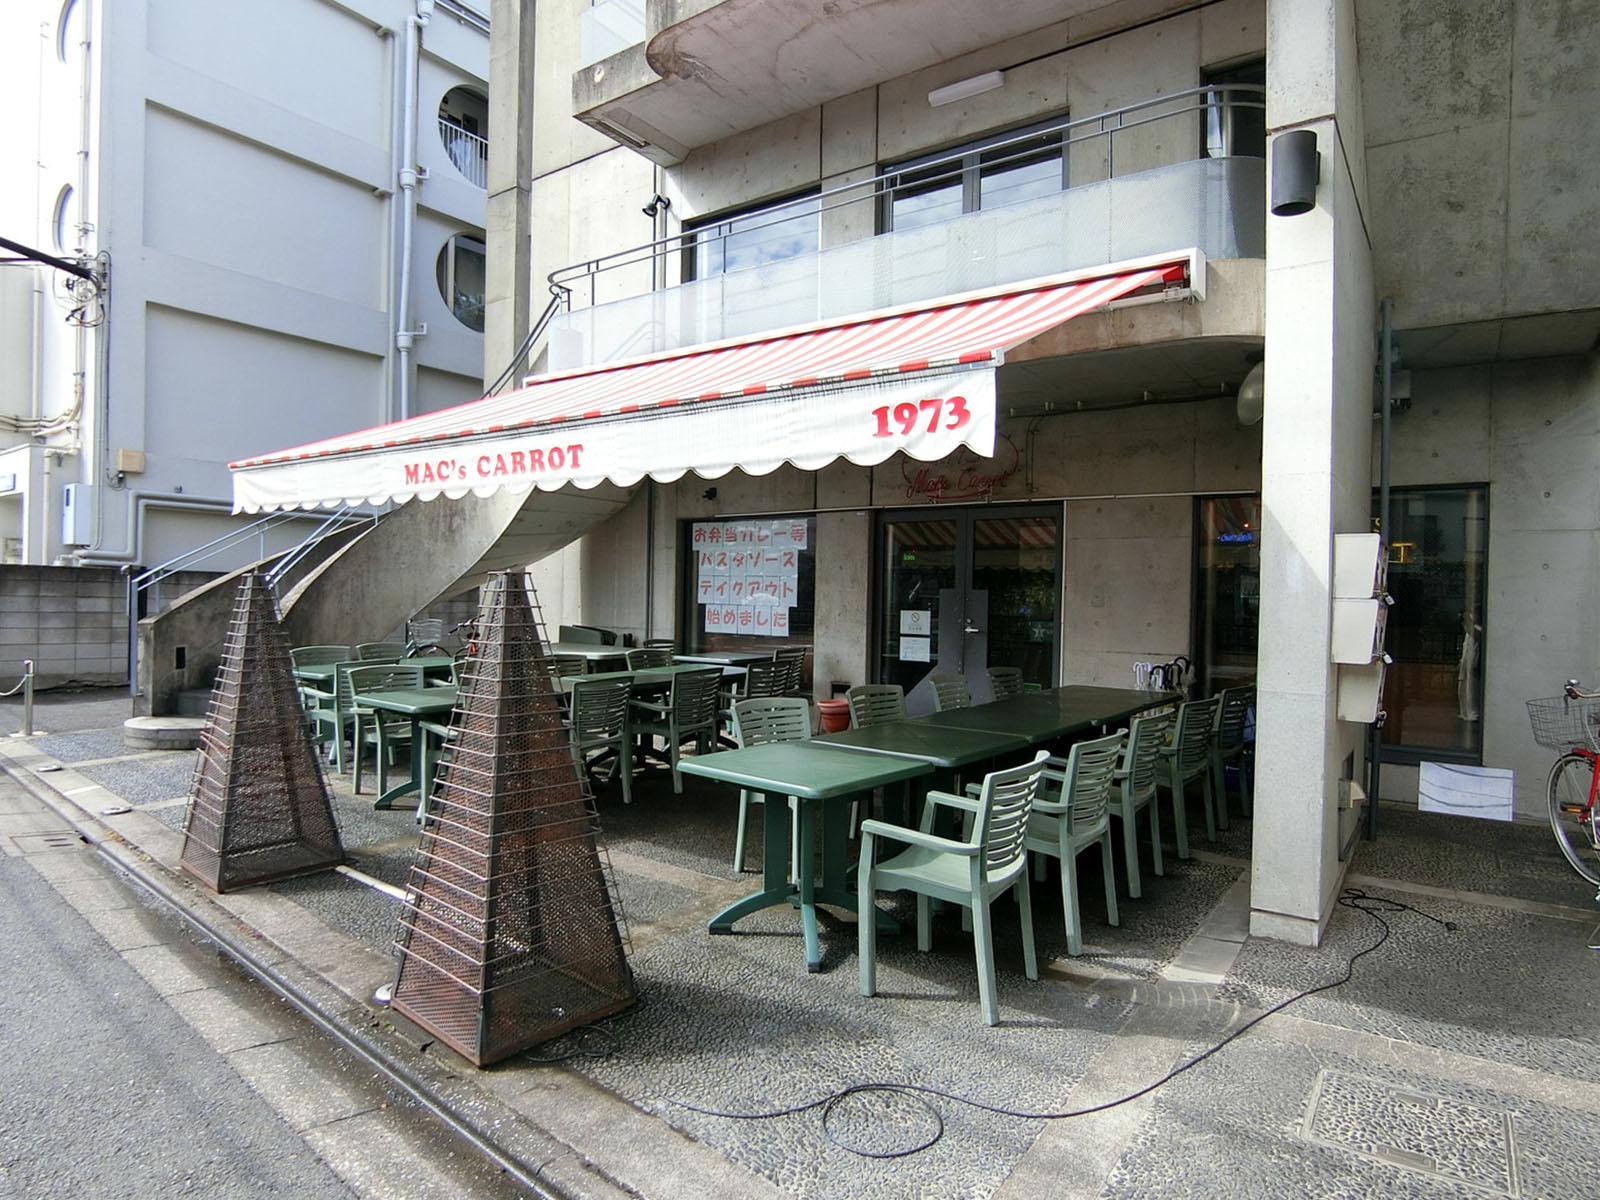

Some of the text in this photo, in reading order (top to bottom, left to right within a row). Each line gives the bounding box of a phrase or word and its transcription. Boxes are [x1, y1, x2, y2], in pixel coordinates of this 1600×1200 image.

[872, 395, 971, 438] 1973
[405, 444, 584, 485] MAC's CARROT
[694, 524, 806, 543] お弁当カレー等
[701, 551, 795, 568] パスタソース
[700, 580, 794, 598] テイクアウト
[707, 608, 787, 627] 始めました
